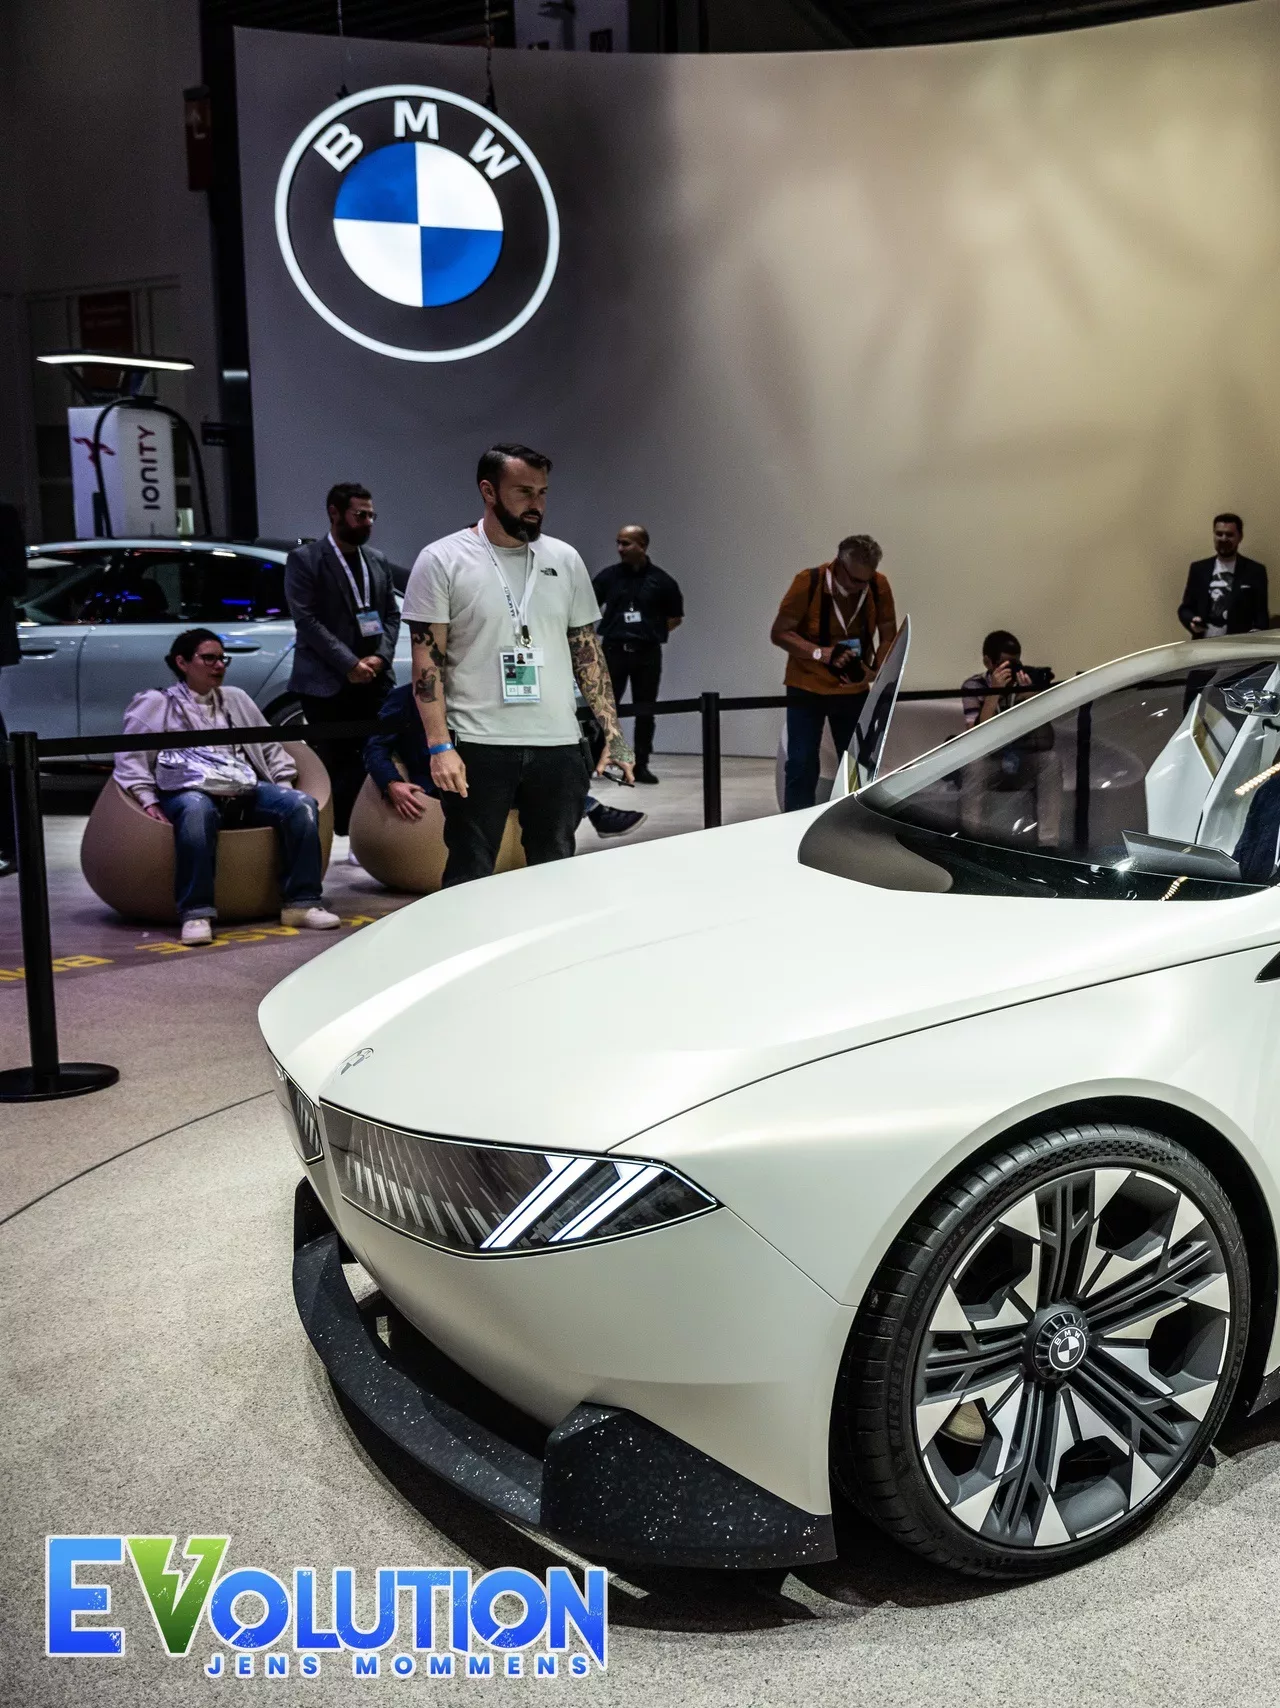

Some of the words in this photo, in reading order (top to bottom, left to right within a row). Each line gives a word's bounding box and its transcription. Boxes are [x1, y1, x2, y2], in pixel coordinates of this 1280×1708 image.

[313, 100, 521, 180] BMW
[137, 425, 161, 510] IONITY
[1053, 1329, 1082, 1346] BMW
[891, 1325, 912, 1447] MICHELIN
